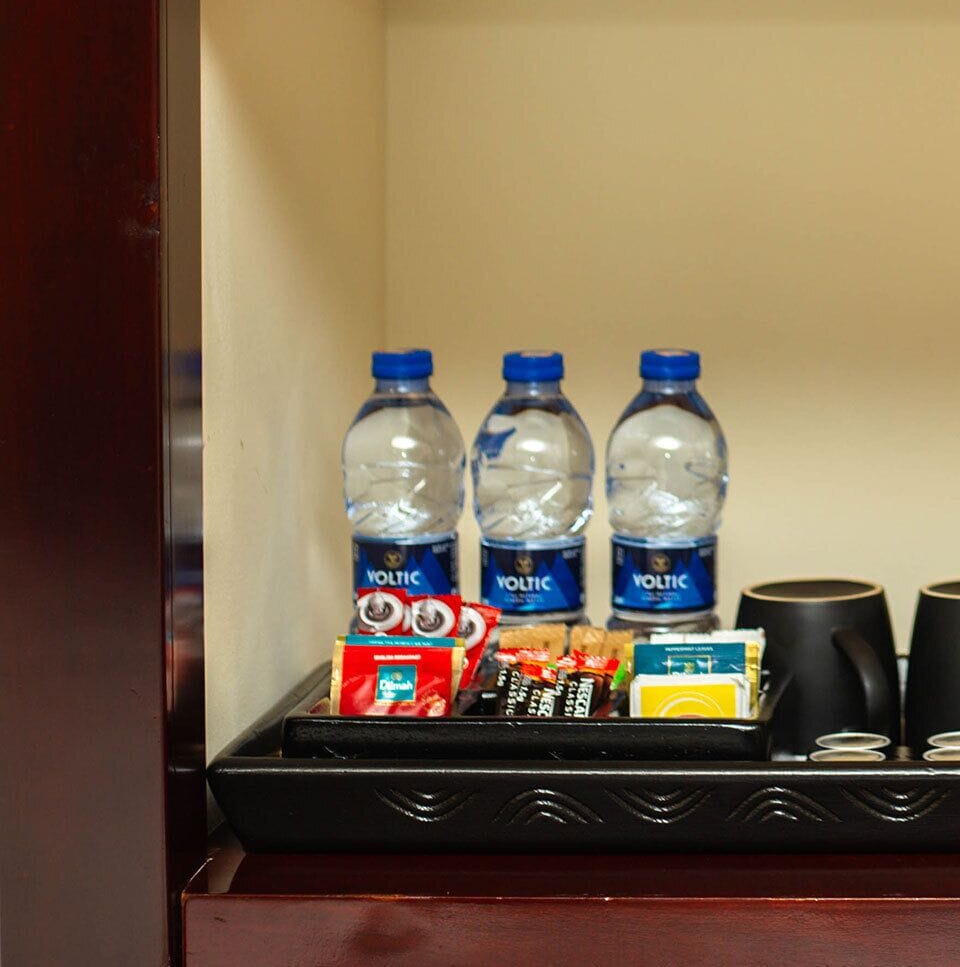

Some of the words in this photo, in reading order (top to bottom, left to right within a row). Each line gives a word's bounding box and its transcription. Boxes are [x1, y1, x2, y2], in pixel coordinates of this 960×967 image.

[366, 570, 420, 586] VOLTIC
[496, 575, 551, 591] VOLTIC
[632, 573, 688, 590] VOLTIC
[379, 679, 413, 691] Dilmah
[506, 670, 521, 716] CLASSIC
[527, 688, 541, 717] CLAS
